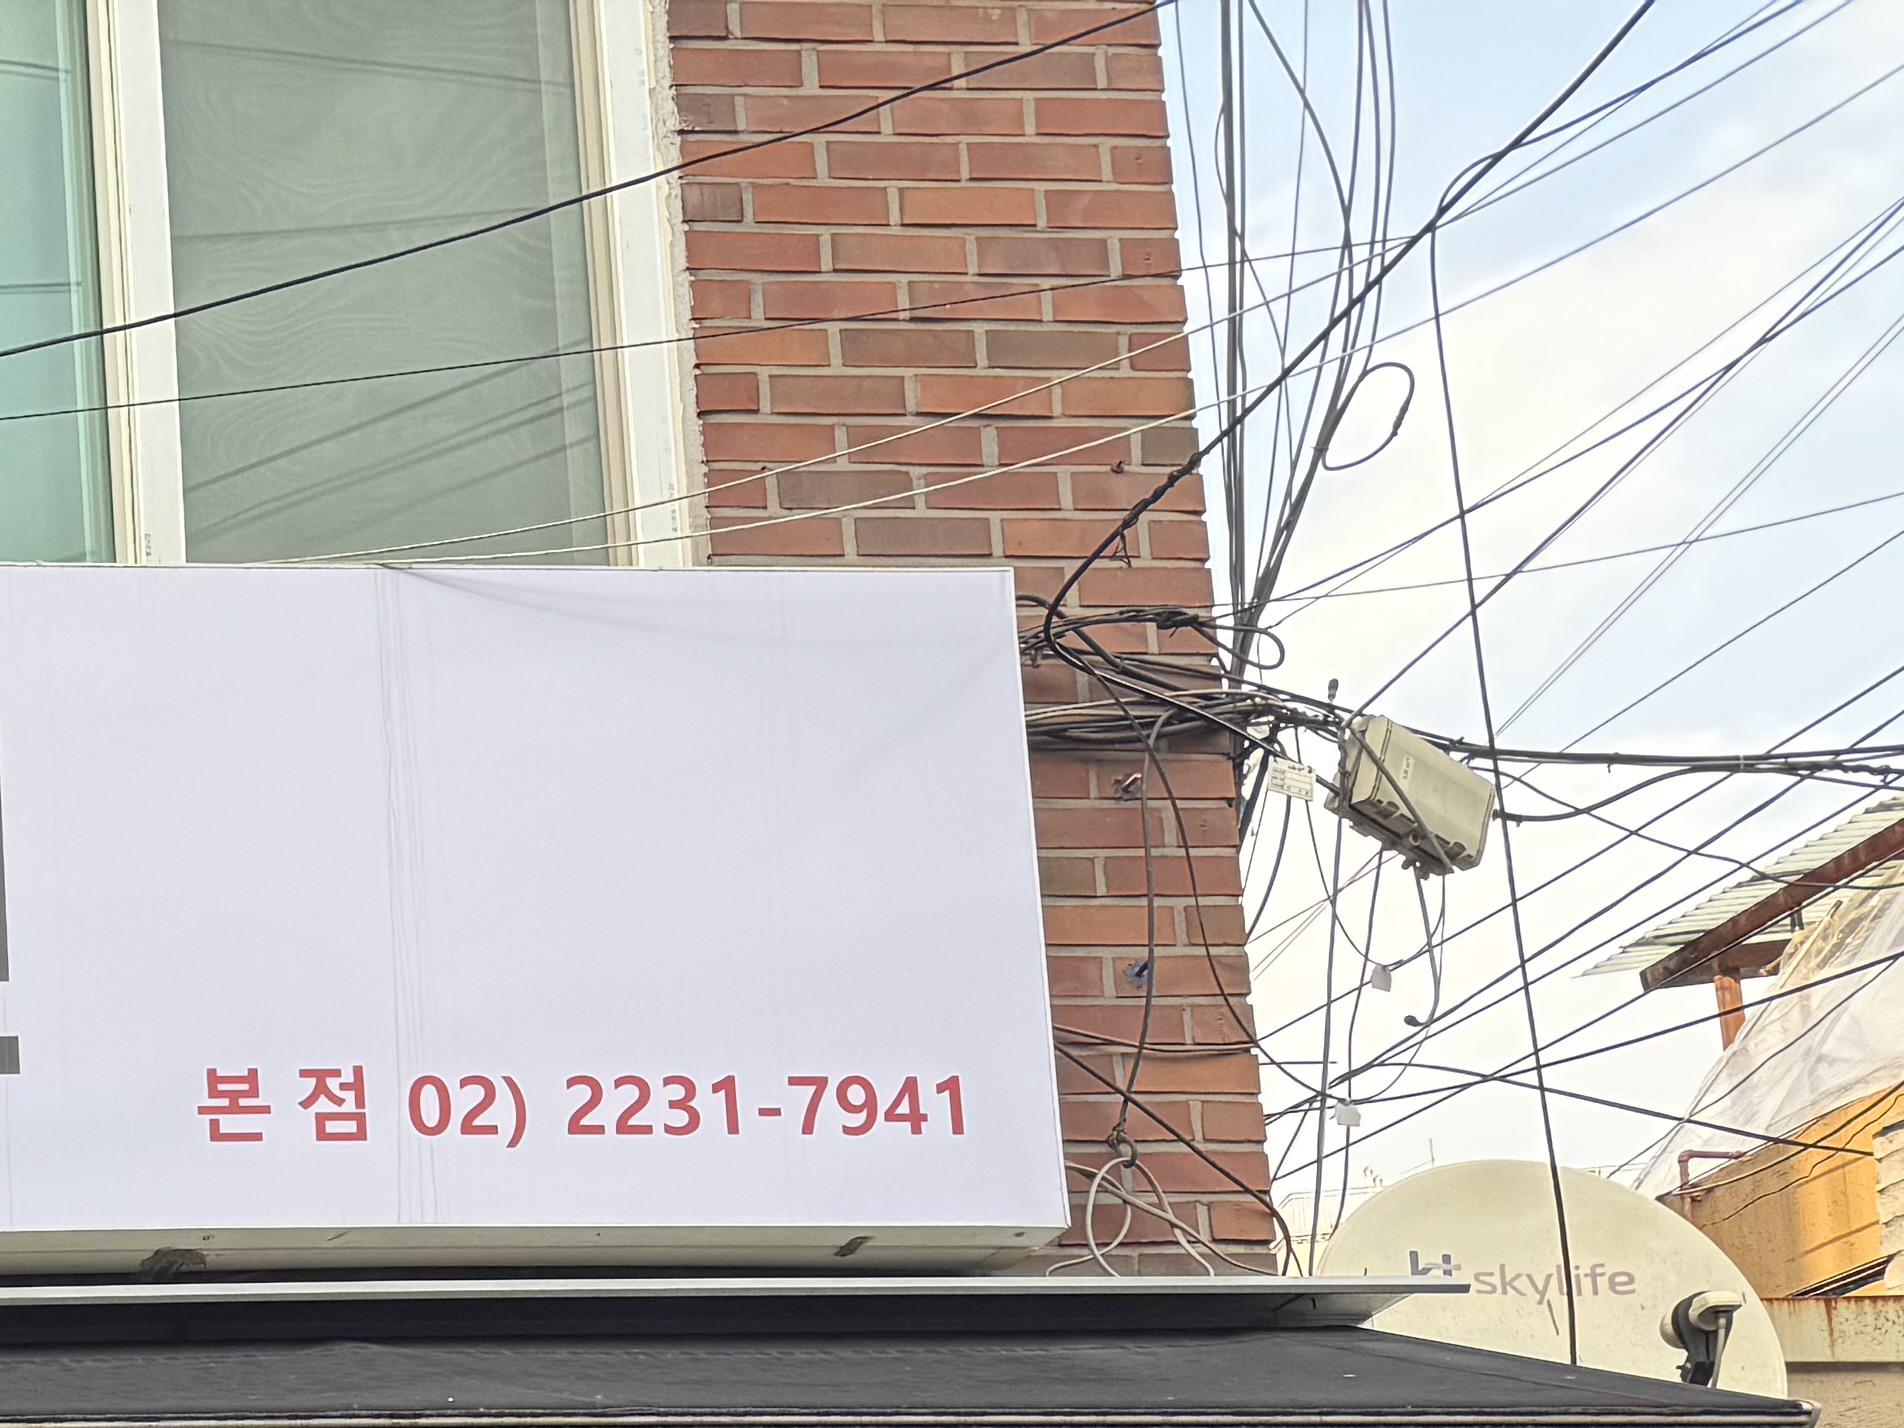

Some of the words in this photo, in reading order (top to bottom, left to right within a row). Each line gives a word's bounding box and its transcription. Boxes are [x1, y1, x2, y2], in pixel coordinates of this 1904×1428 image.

[407, 1074, 527, 1148] 02)
[565, 1074, 966, 1138] 2231-7941
[1473, 1263, 1636, 1305] skylife
